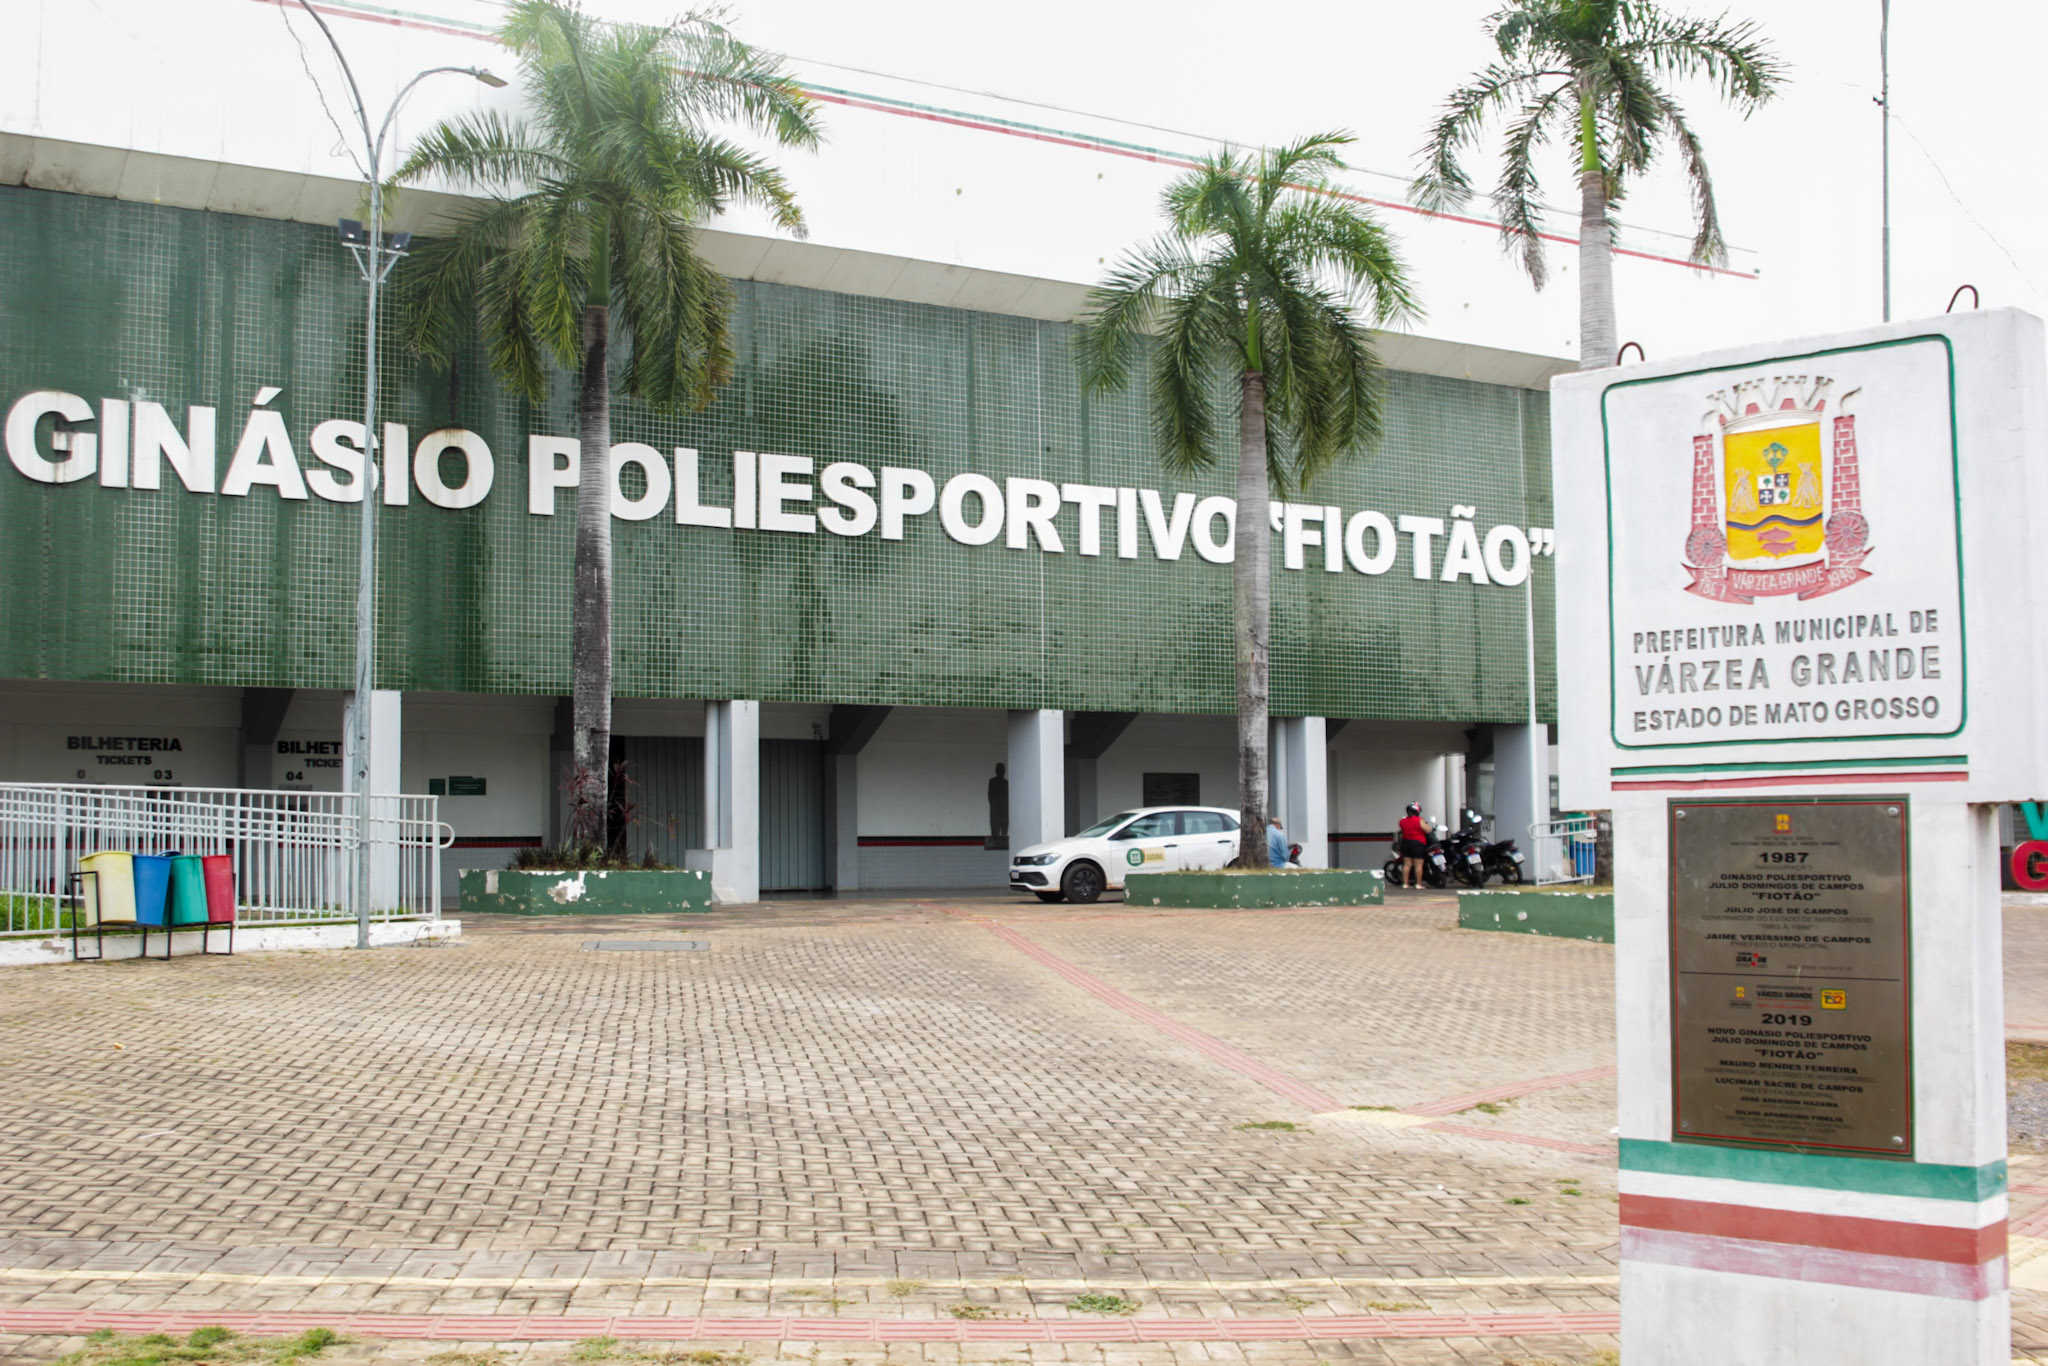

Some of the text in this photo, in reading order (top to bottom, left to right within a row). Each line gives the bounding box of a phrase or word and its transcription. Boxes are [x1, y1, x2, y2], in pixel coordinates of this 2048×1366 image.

[5, 387, 495, 509] GINÁSIO
[529, 434, 1238, 563] POLIESPORTIVO
[1780, 565, 1824, 589] GRANDE
[1827, 567, 1857, 588] 1948
[1633, 609, 1938, 654] PREFEITURA MUNICIPAL DE
[1635, 646, 1941, 696] VÁRZEA GRANDE
[1634, 696, 1939, 732] ESTADO DE MATO GROSSO
[67, 736, 183, 752] BILHETERIA
[96, 755, 152, 766] TICKETS
[286, 771, 304, 781] 04
[1760, 852, 1809, 863] 1987
[1721, 873, 1852, 882] GINÁSIO POLIESPORTIVO
[1742, 882, 1798, 890] DOMINGOS
[1752, 892, 1821, 901] "FIOTÃO"
[1787, 907, 1800, 915] DE
[1740, 934, 1801, 942] VERÍSSIMO
[1761, 1013, 1813, 1026] 2019
[1708, 1027, 1872, 1042] NOVO GINÁSIO POLIESPORTIVO
[1744, 1038, 1801, 1047] DOMINGOS
[1821, 1042, 1867, 1050] CAMPOS
[1754, 1049, 1824, 1060] "FIOTÃO"
[1719, 1060, 1858, 1074] MAURO MENDES FERREIRA
[1715, 1077, 1760, 1086] LUCIMAR
[1764, 1080, 1798, 1088] SACRE
[1818, 1083, 1864, 1093] CAMPOS
